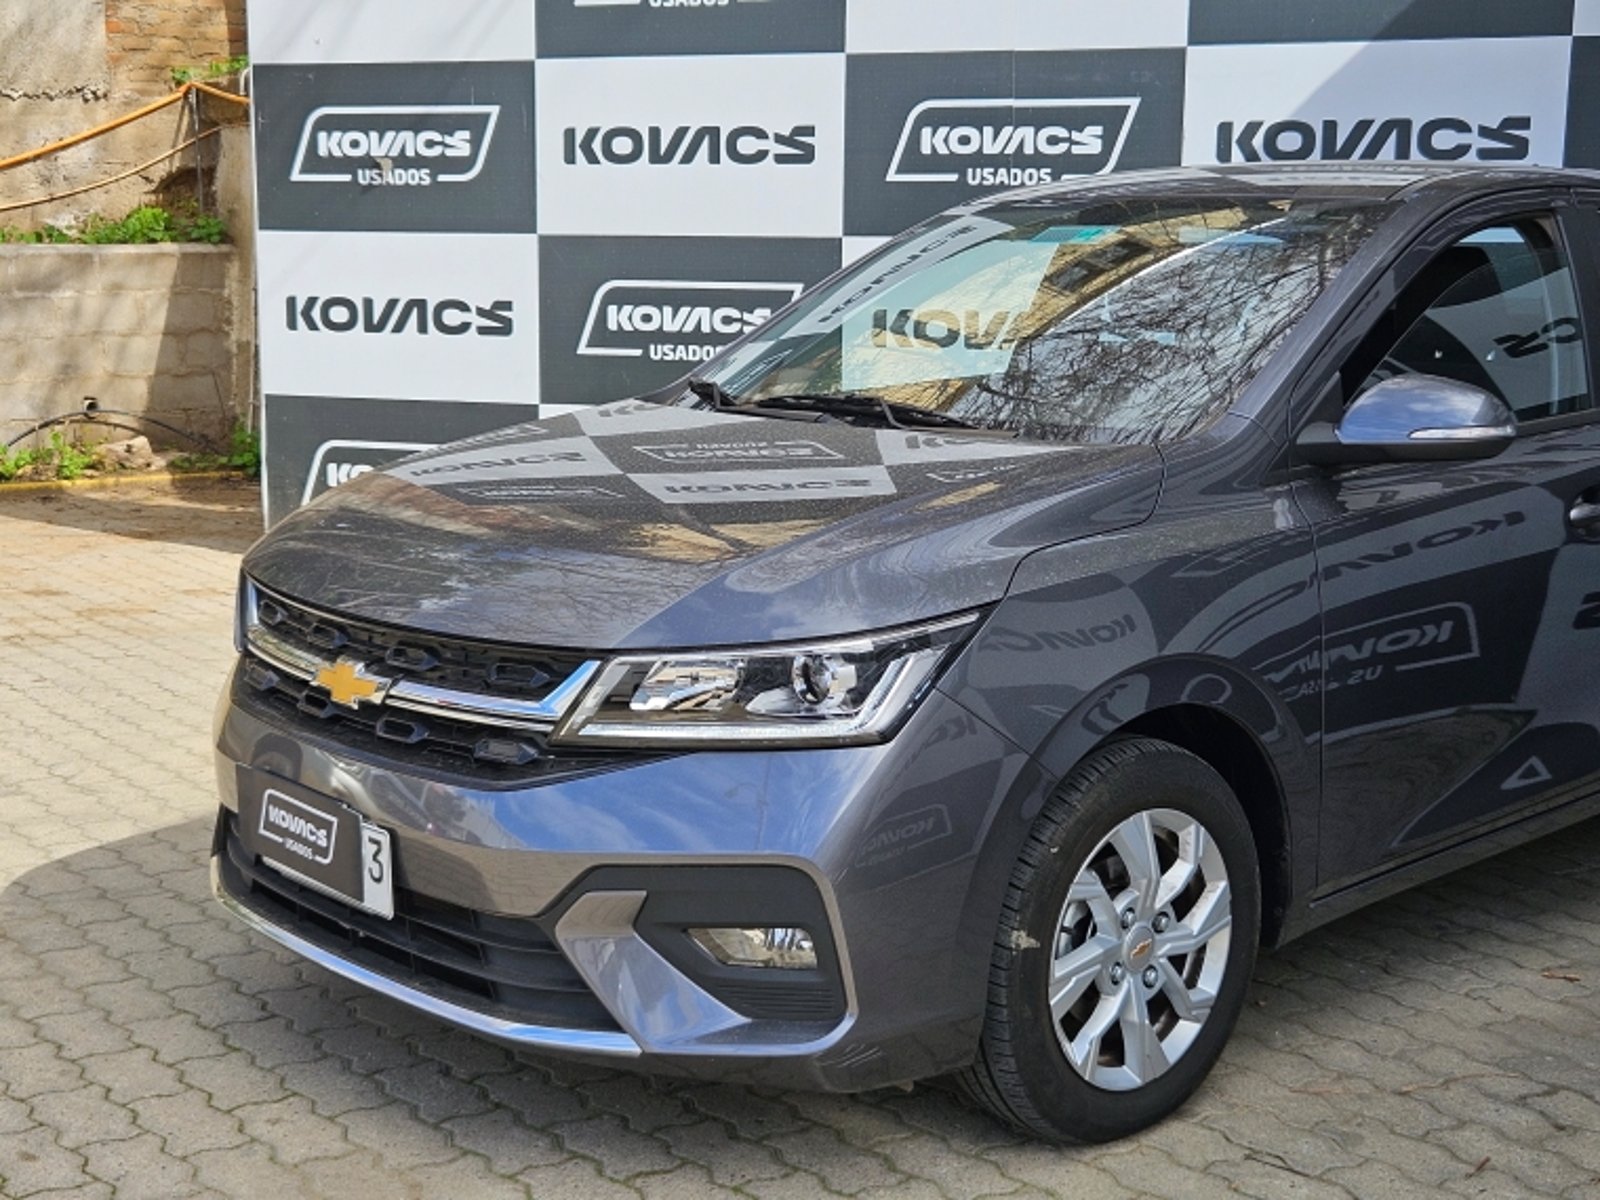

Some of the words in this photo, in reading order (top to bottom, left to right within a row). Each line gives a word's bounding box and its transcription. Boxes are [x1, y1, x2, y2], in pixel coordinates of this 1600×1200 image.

[317, 130, 471, 157] KOVACS
[563, 126, 815, 165] KOVACS
[920, 126, 1104, 155] KOVACS
[1216, 116, 1531, 163] KOVACS
[356, 168, 431, 186] USADOS
[967, 167, 1051, 186] USADOS
[286, 295, 513, 337] KOVACS
[649, 344, 724, 361] USADO
[268, 804, 328, 848] KOVACS
[368, 837, 384, 884] 3
